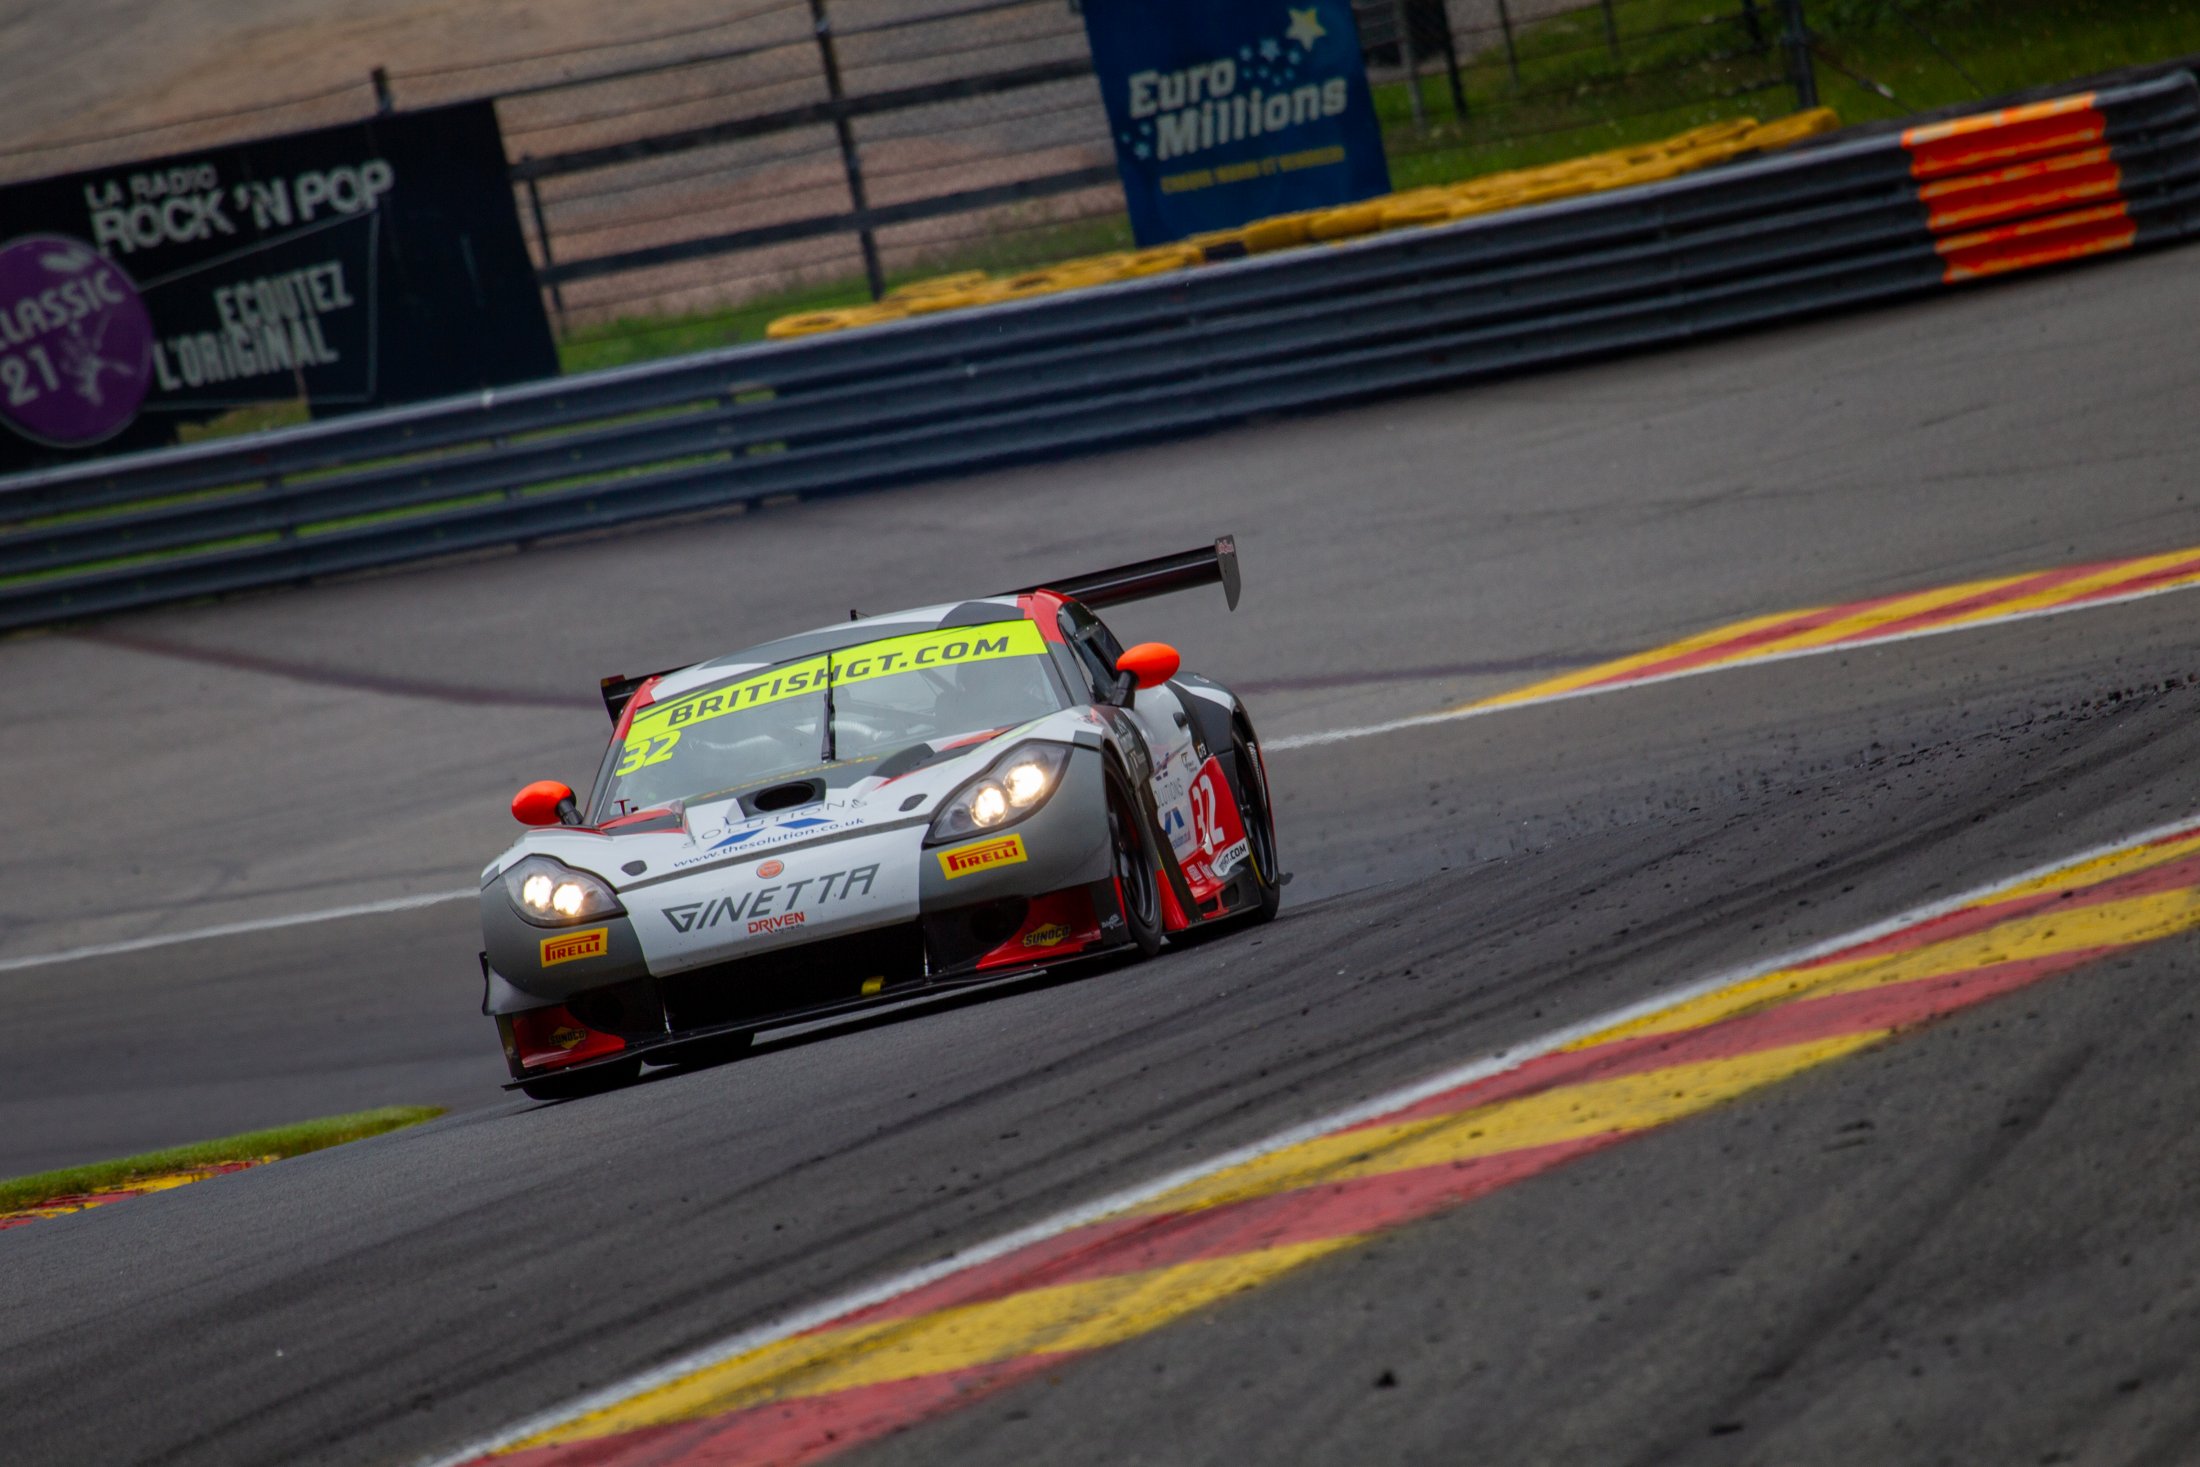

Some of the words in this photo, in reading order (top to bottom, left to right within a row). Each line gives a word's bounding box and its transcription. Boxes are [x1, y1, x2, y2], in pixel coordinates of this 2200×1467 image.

[1129, 58, 1236, 118] Euro
[1156, 77, 1346, 160] Millions
[84, 183, 124, 210] LA
[129, 163, 218, 198] RADIO
[92, 193, 235, 255] ROCK
[297, 158, 393, 221] POP
[0, 269, 124, 343] LASSIC
[215, 261, 353, 328] ECOUTEZ
[0, 346, 60, 406] 21
[667, 636, 1009, 727] BRITISHGT.COM
[615, 730, 682, 778] 32
[673, 817, 866, 868] www.thesolution.co.uk
[1191, 774, 1226, 855] 32
[947, 838, 1020, 873] PIRELLI
[661, 862, 881, 933] GINETTA
[747, 910, 806, 934] DRIVEN
[544, 933, 602, 963] PIRELLI
[1024, 925, 1072, 947] SUNOCO
